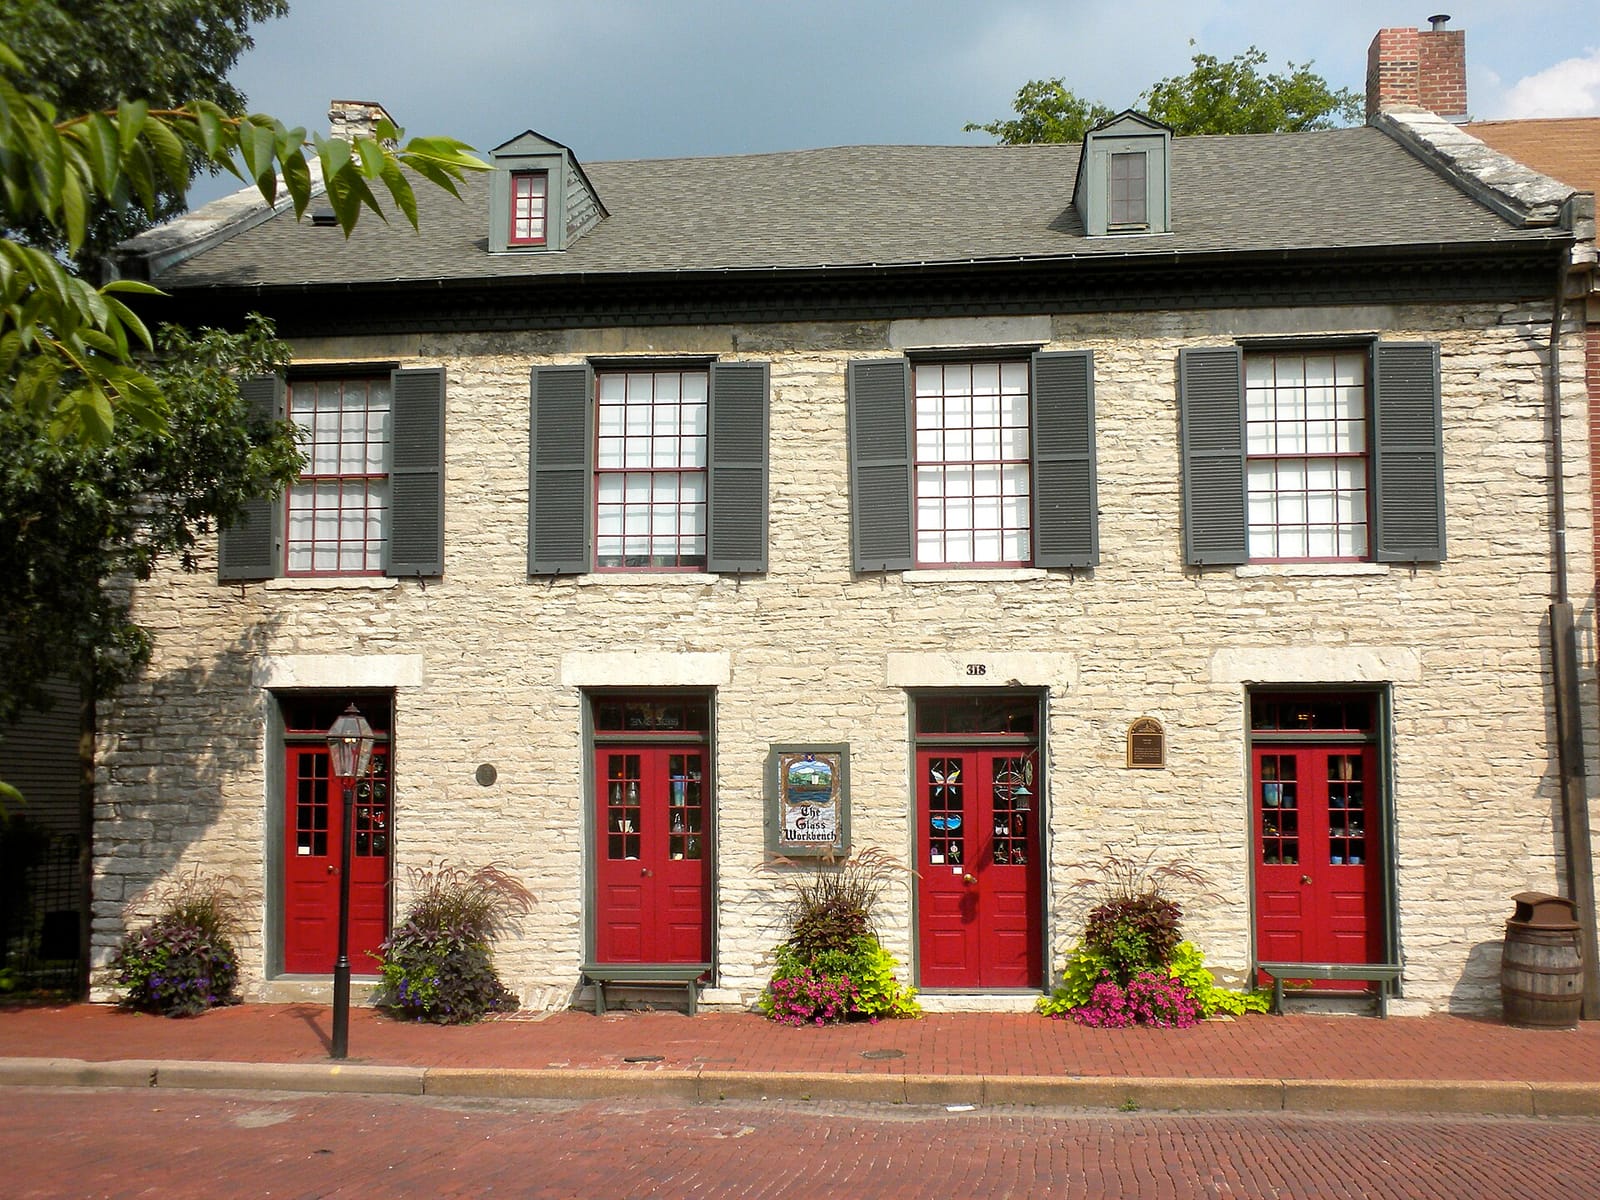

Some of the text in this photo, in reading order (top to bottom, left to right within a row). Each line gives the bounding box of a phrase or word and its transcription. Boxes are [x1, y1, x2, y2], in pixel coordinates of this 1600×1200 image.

[966, 664, 986, 675] 318
[800, 805, 820, 819] The
[796, 817, 826, 830] Glass
[784, 829, 836, 842] Workbench
